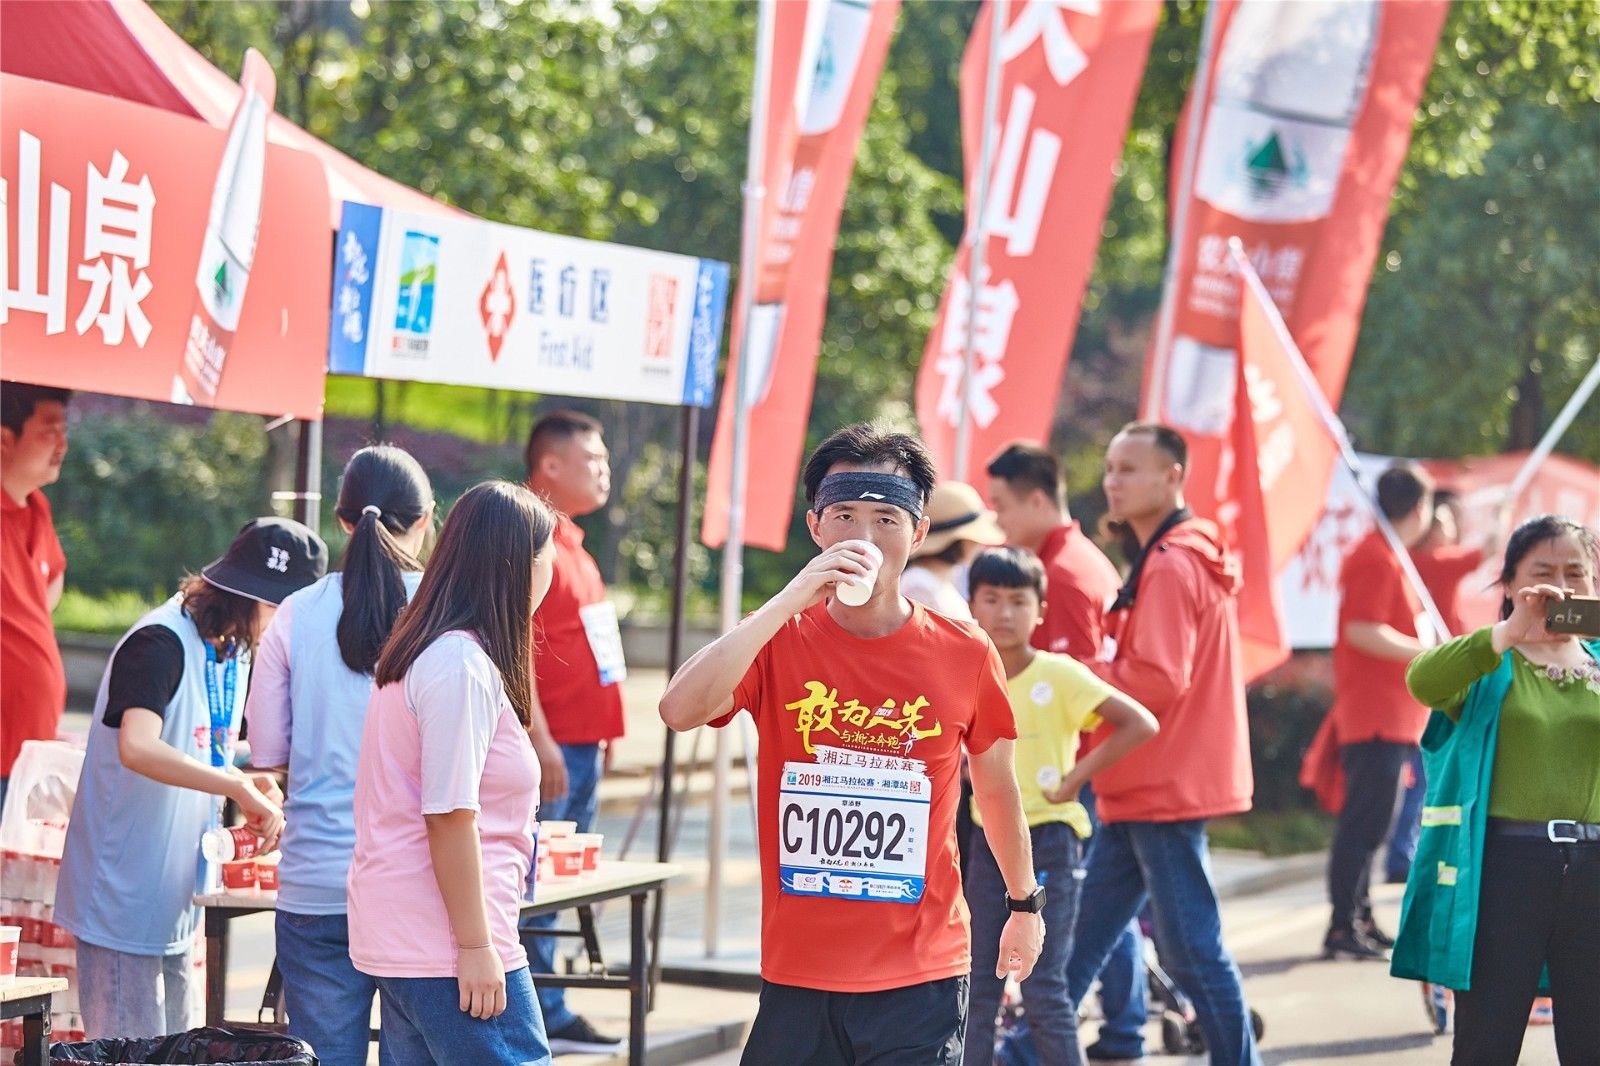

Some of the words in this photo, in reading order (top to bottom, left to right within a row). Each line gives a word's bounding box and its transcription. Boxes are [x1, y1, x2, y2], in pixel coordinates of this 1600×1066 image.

[0, 128, 157, 348] 山泉
[785, 680, 943, 755] 敢为人先
[798, 773, 821, 786] 2019
[823, 750, 915, 771] 湘江马拉松赛
[782, 803, 906, 862] C10292
